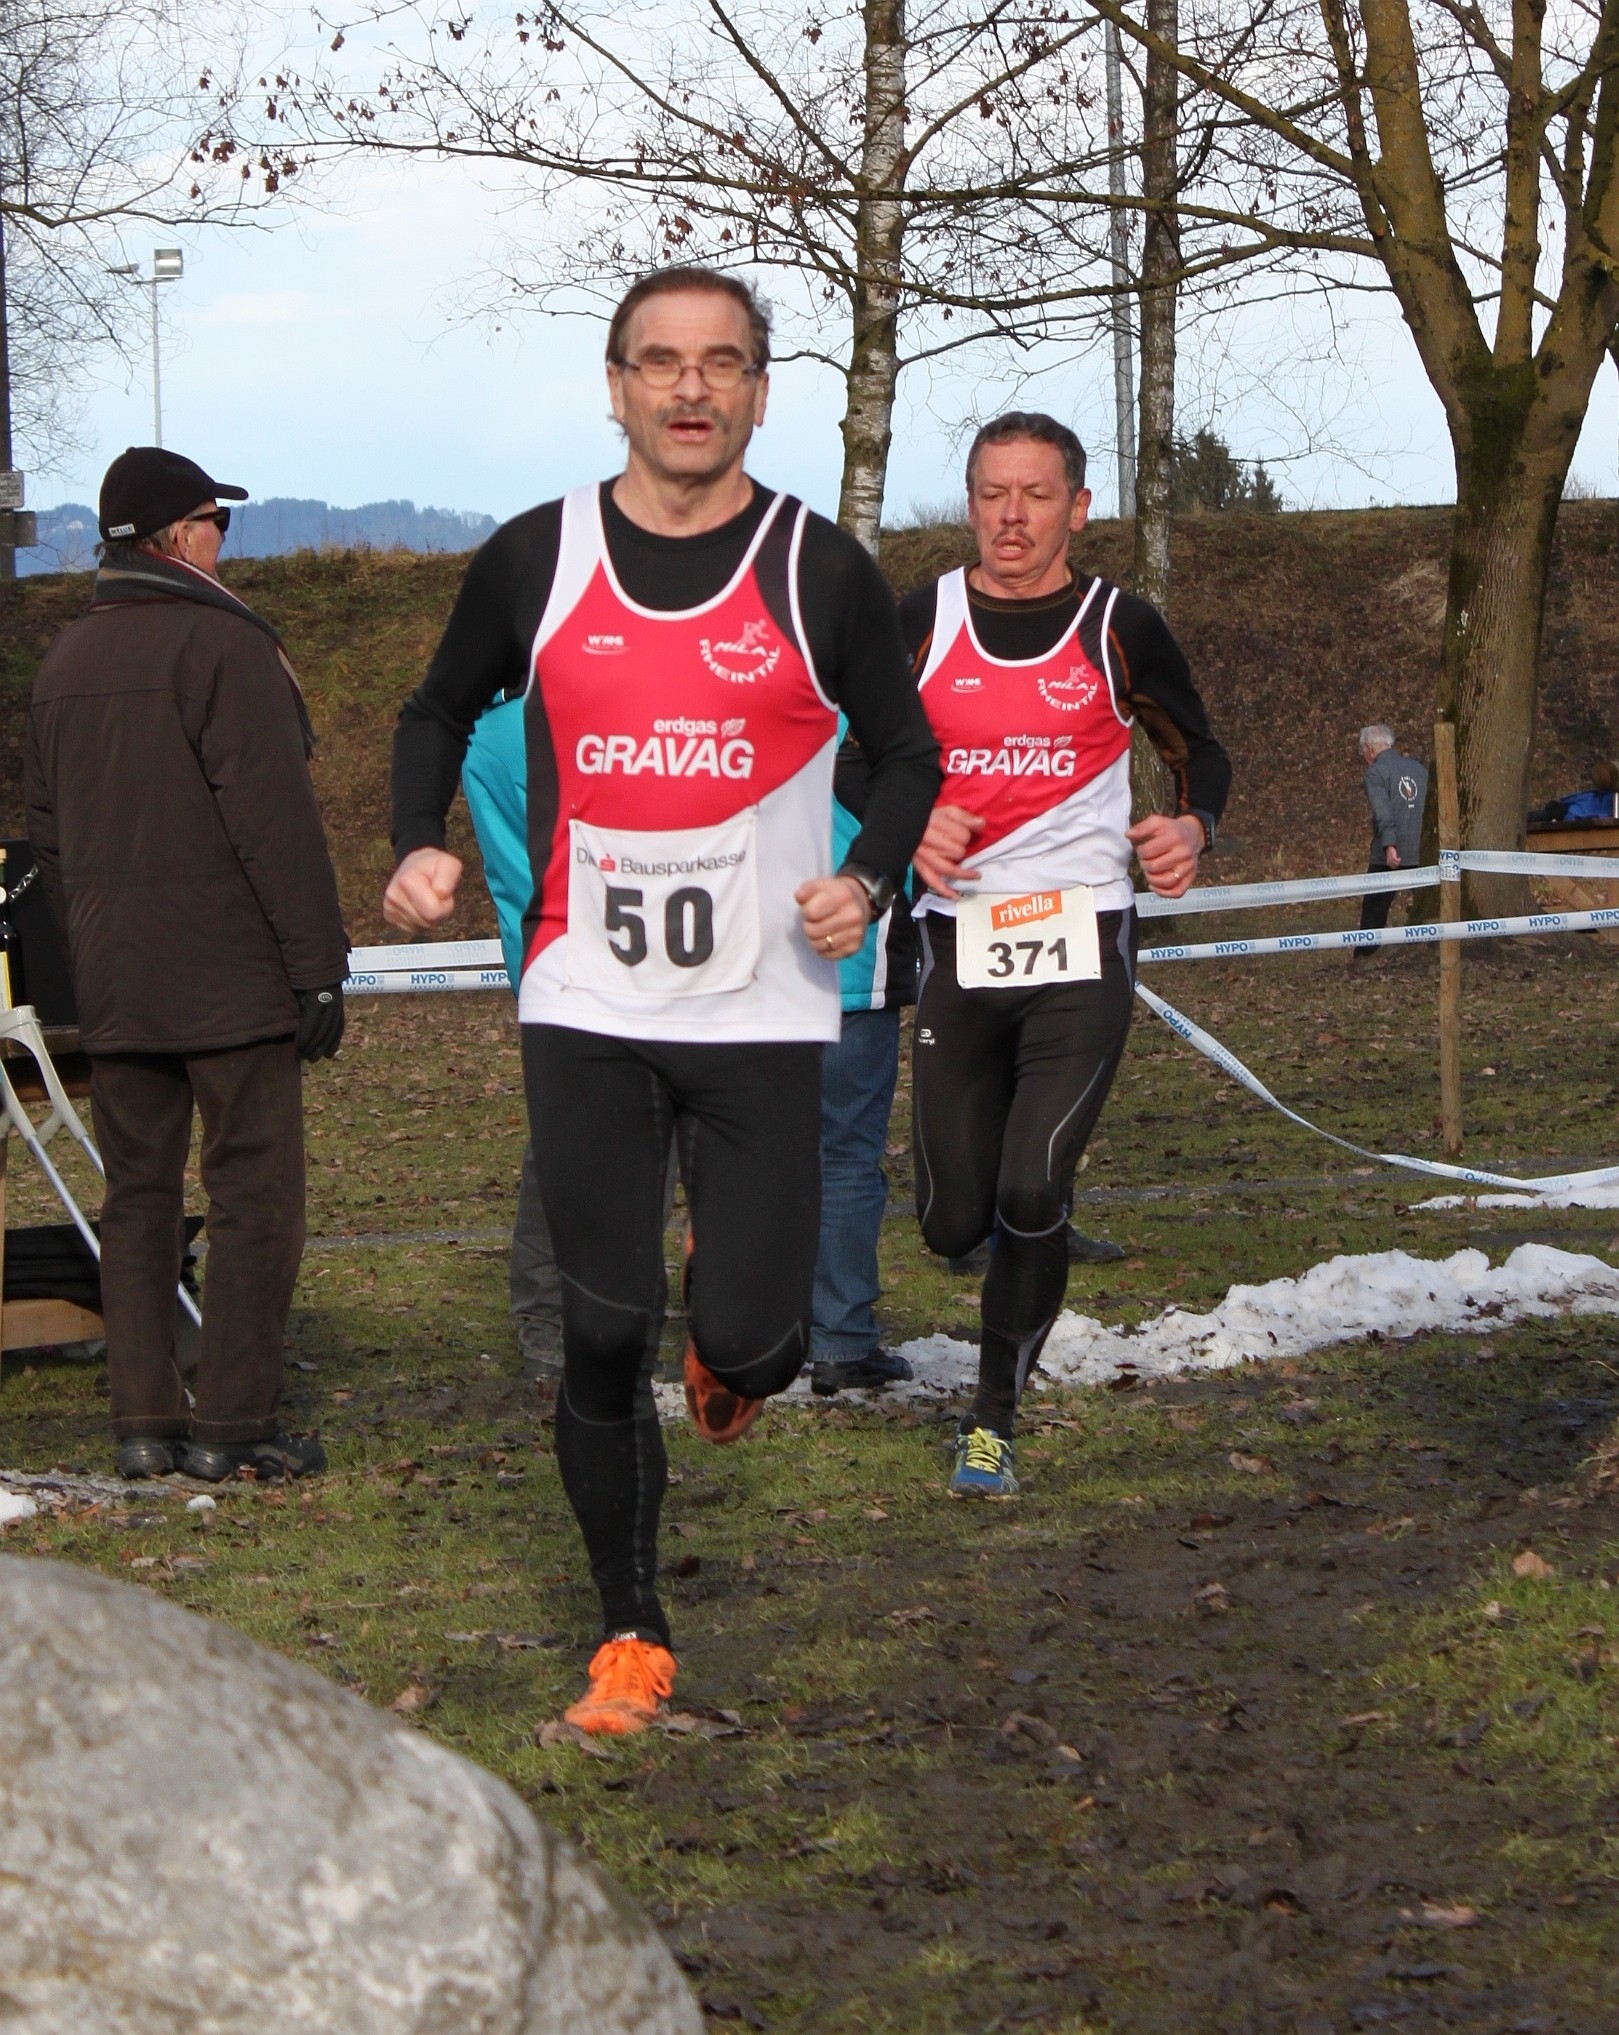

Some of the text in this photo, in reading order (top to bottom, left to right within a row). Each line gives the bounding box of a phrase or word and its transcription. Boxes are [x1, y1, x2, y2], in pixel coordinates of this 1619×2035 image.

[700, 638, 781, 683] RHEINTAL
[1037, 678, 1098, 711] RHEINTAL
[653, 717, 717, 736] erdgas
[1004, 734, 1050, 748] erdgas
[575, 734, 755, 779] GRAVAG
[947, 748, 1077, 777] GRAVAG
[621, 850, 747, 877] Bausparkasse
[1440, 852, 1460, 861] YPO
[999, 894, 1054, 924] rivella
[605, 884, 714, 968] 50
[1150, 947, 1184, 959] HYPO
[1215, 942, 1248, 954] HYPO
[1279, 937, 1312, 948] HYPO
[1342, 931, 1375, 943] HYPO
[1405, 926, 1437, 938] HYPO
[1467, 921, 1499, 932] HYPO
[1529, 915, 1560, 927] HYPO
[986, 937, 1069, 978] 371
[411, 974, 447, 984] HYPO
[480, 972, 509, 983] HYP
[1163, 1010, 1192, 1039] HYPO
